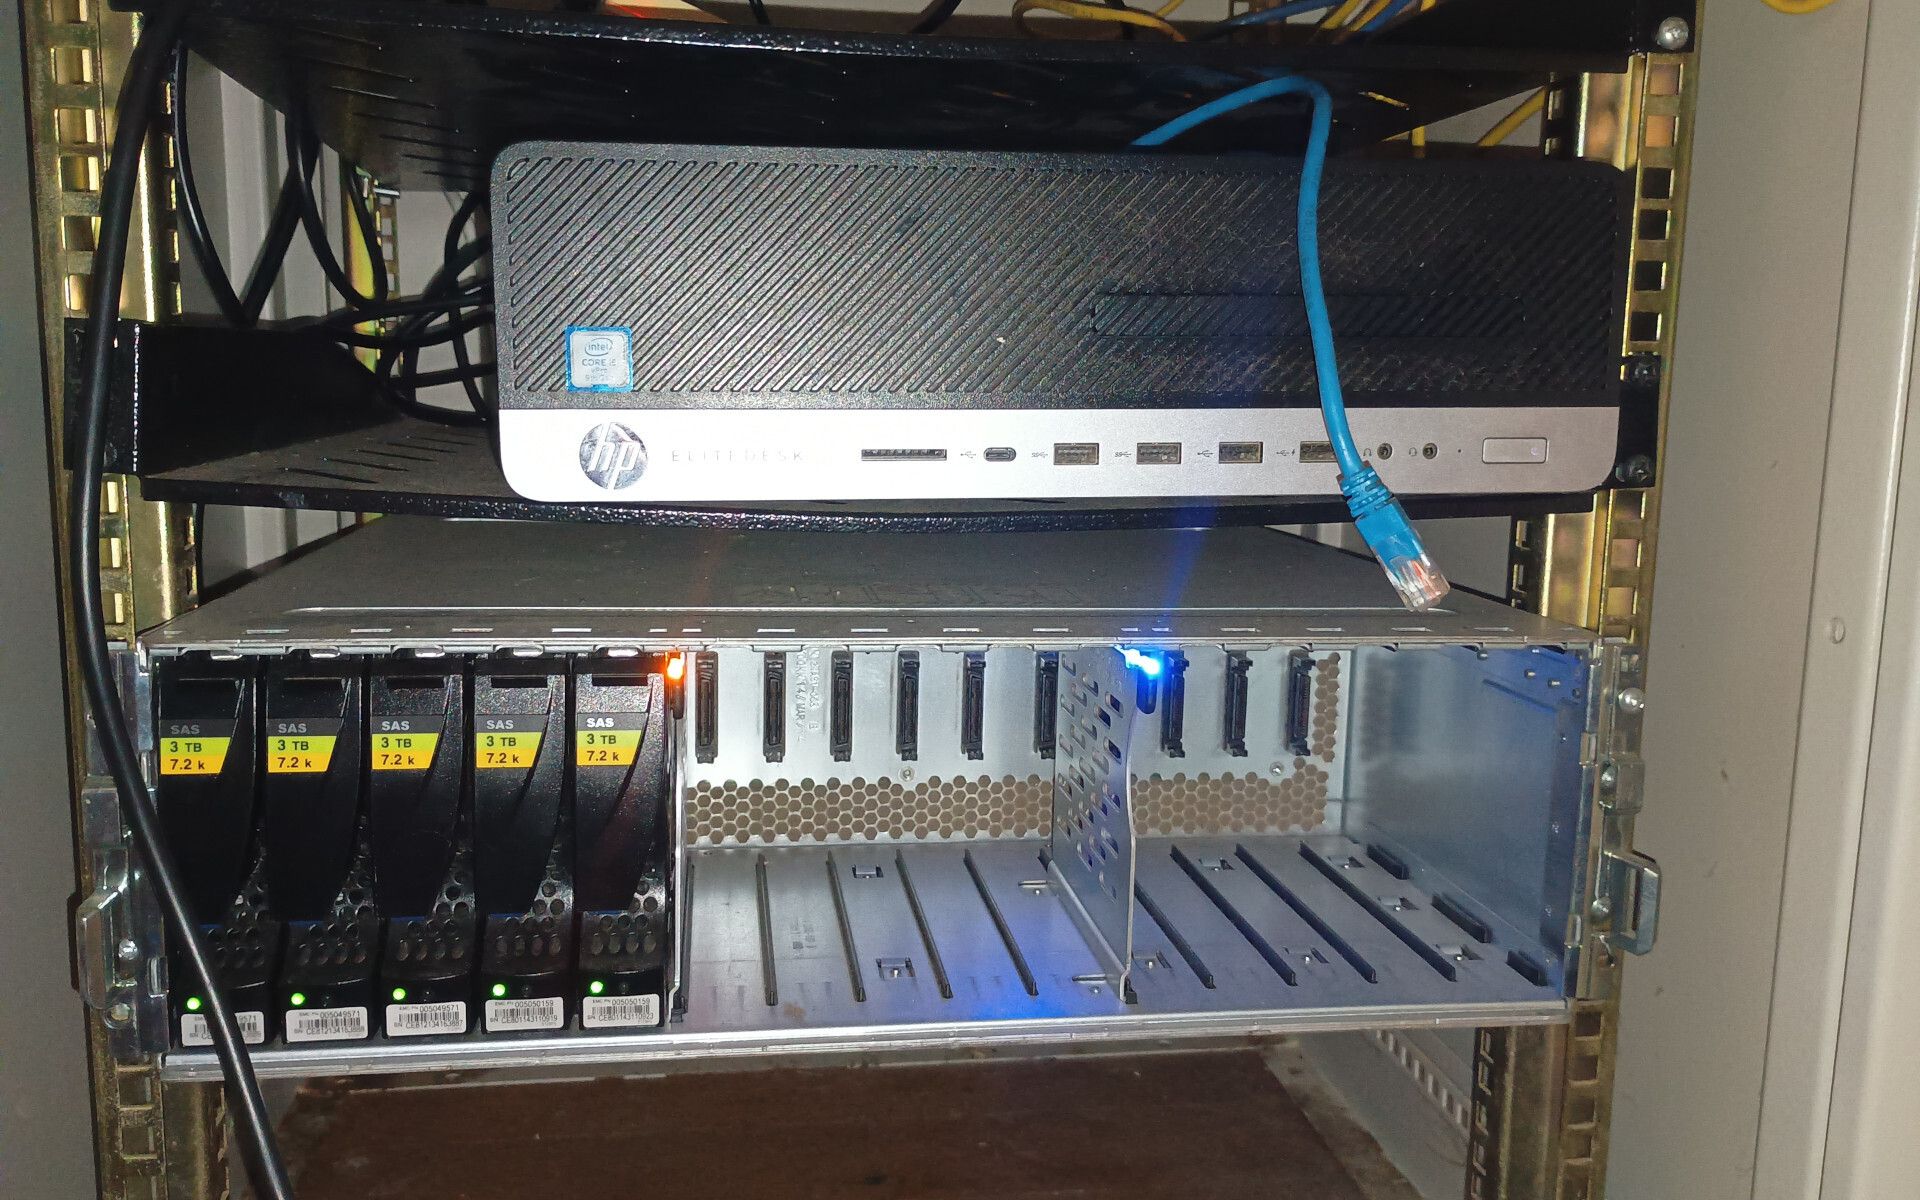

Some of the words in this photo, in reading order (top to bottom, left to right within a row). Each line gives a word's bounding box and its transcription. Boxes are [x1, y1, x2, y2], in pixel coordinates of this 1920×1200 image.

[581, 358, 607, 367] CORE
[587, 422, 641, 490] hp
[278, 723, 307, 734] SAS
[381, 720, 410, 731] SAS
[486, 720, 514, 730] SAS
[586, 718, 614, 728] SAS
[170, 724, 200, 735] SAS
[381, 737, 389, 748] 3
[396, 738, 412, 748] TB
[486, 735, 494, 747] 3
[500, 737, 517, 747] TB
[587, 733, 595, 745] 3
[600, 734, 617, 745] TB
[170, 741, 178, 753] 3
[185, 743, 202, 753] TB
[278, 740, 286, 751] 3
[292, 741, 309, 751] TB
[381, 754, 402, 765] 7.2
[408, 755, 415, 765] k
[486, 752, 507, 763] 7.2
[512, 753, 519, 763] k
[587, 750, 607, 762] 7.2
[612, 751, 619, 762] k
[170, 759, 192, 770] 7.2
[198, 760, 205, 770] k
[278, 757, 299, 768] 7.2
[305, 758, 312, 768] k
[420, 1004, 459, 1013] 005049571
[514, 1000, 554, 1008] 005050159
